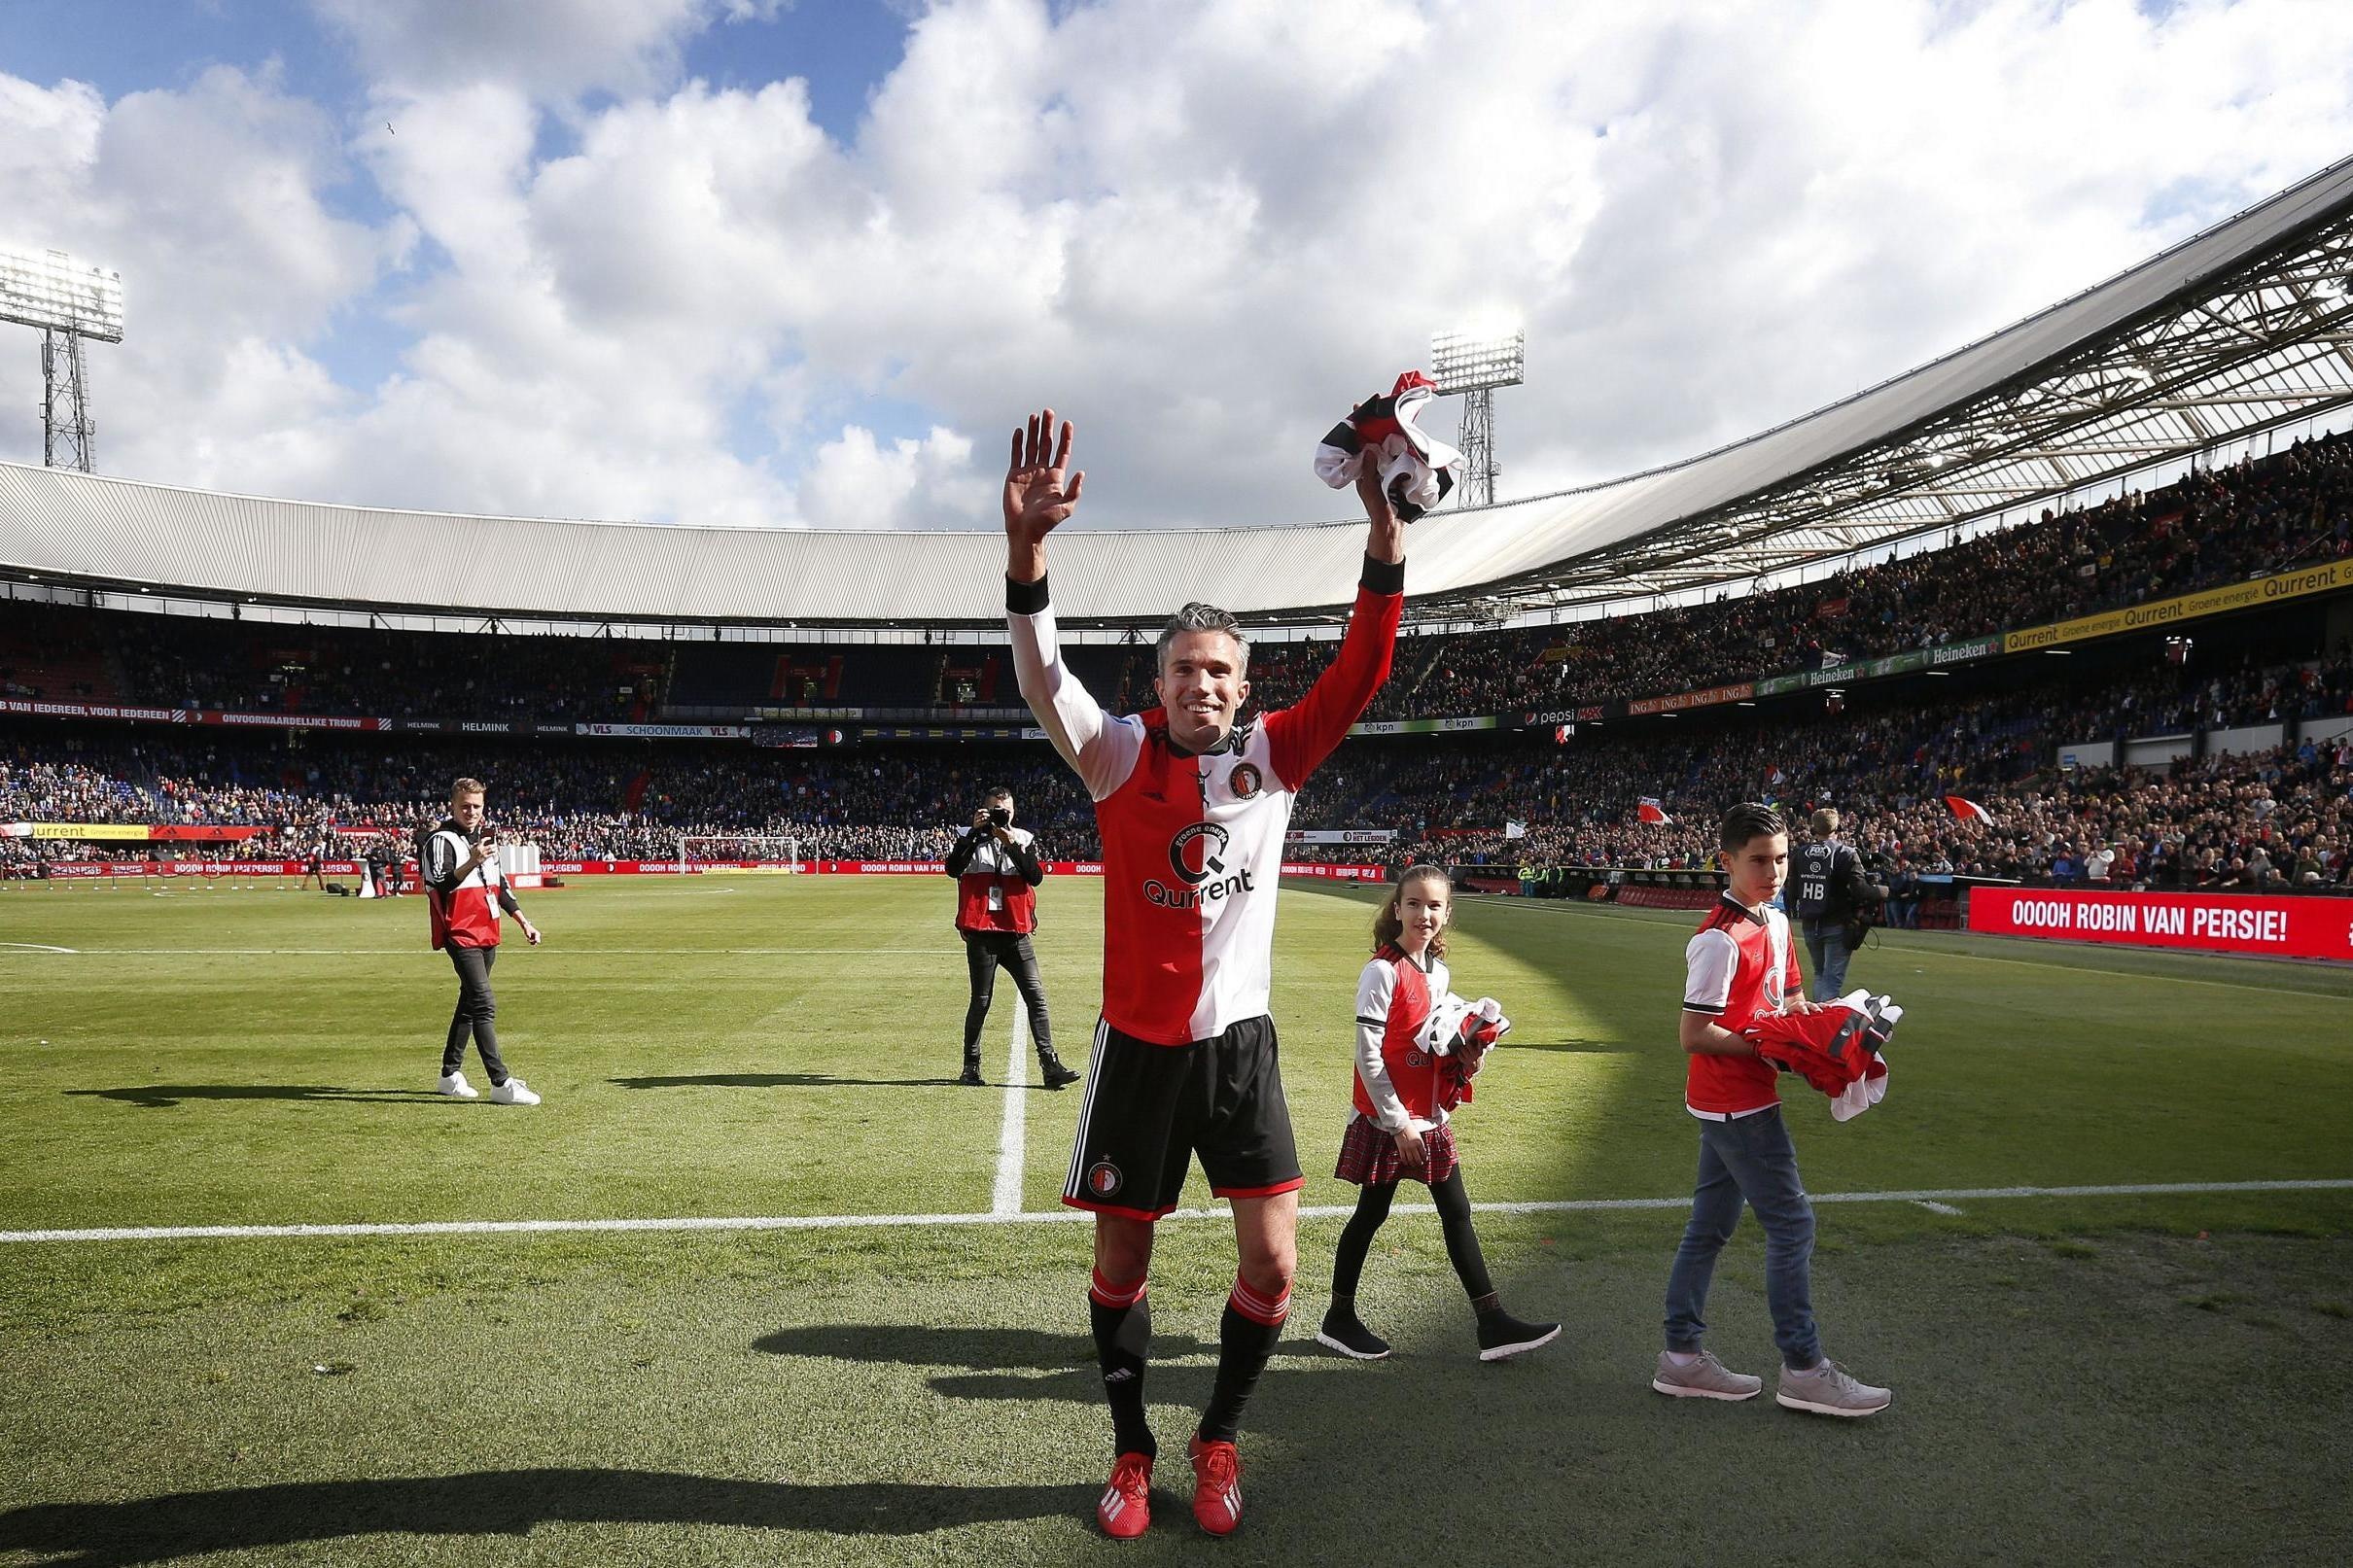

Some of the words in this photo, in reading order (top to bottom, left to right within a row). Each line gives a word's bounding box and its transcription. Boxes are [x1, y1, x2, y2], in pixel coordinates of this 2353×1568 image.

[2009, 627, 2058, 649] Qurrent
[2062, 623, 2090, 638] Groene
[2091, 617, 2121, 633] energie
[2125, 601, 2184, 626] Qurrent
[2189, 596, 2221, 611] Groene
[2223, 588, 2259, 605] energie
[2265, 567, 2337, 597] Qurrent
[1933, 642, 1986, 664] Heineken
[1810, 667, 1854, 685] Heineken
[1691, 694, 1707, 705] ING
[1722, 688, 1739, 700] ING
[10, 702, 31, 712] VAN
[34, 704, 88, 716] IEDEREEN,
[89, 707, 118, 717] VOOR
[121, 709, 169, 719] IEDEREEN
[1631, 703, 1648, 714] ING
[1661, 700, 1677, 711] ING
[223, 714, 327, 726] ONVOORWAARDELIJKE
[329, 718, 361, 727] TROUW
[1541, 709, 1574, 725] pepsi
[1576, 706, 1603, 721] MAX
[462, 722, 509, 732] HELMINK
[1376, 723, 1394, 733] kpn
[1457, 719, 1474, 729] kpn
[593, 725, 613, 734] VLS
[626, 725, 703, 736] SCHOONMAAK
[710, 727, 728, 736] VLS
[32, 826, 86, 837] urrent
[1175, 826, 1202, 848] groene
[860, 863, 887, 873] OOOOH
[889, 863, 911, 873] ROBIN
[913, 863, 930, 873] VAN
[1075, 864, 1102, 873] OOOOH
[1143, 868, 1254, 908] Qurrent
[1803, 882, 1824, 900] HB
[2012, 899, 2071, 927] OOOOH
[2077, 902, 2136, 932] ROBIN
[2143, 905, 2186, 935] VAN
[2193, 908, 2287, 941] PERSIE!
